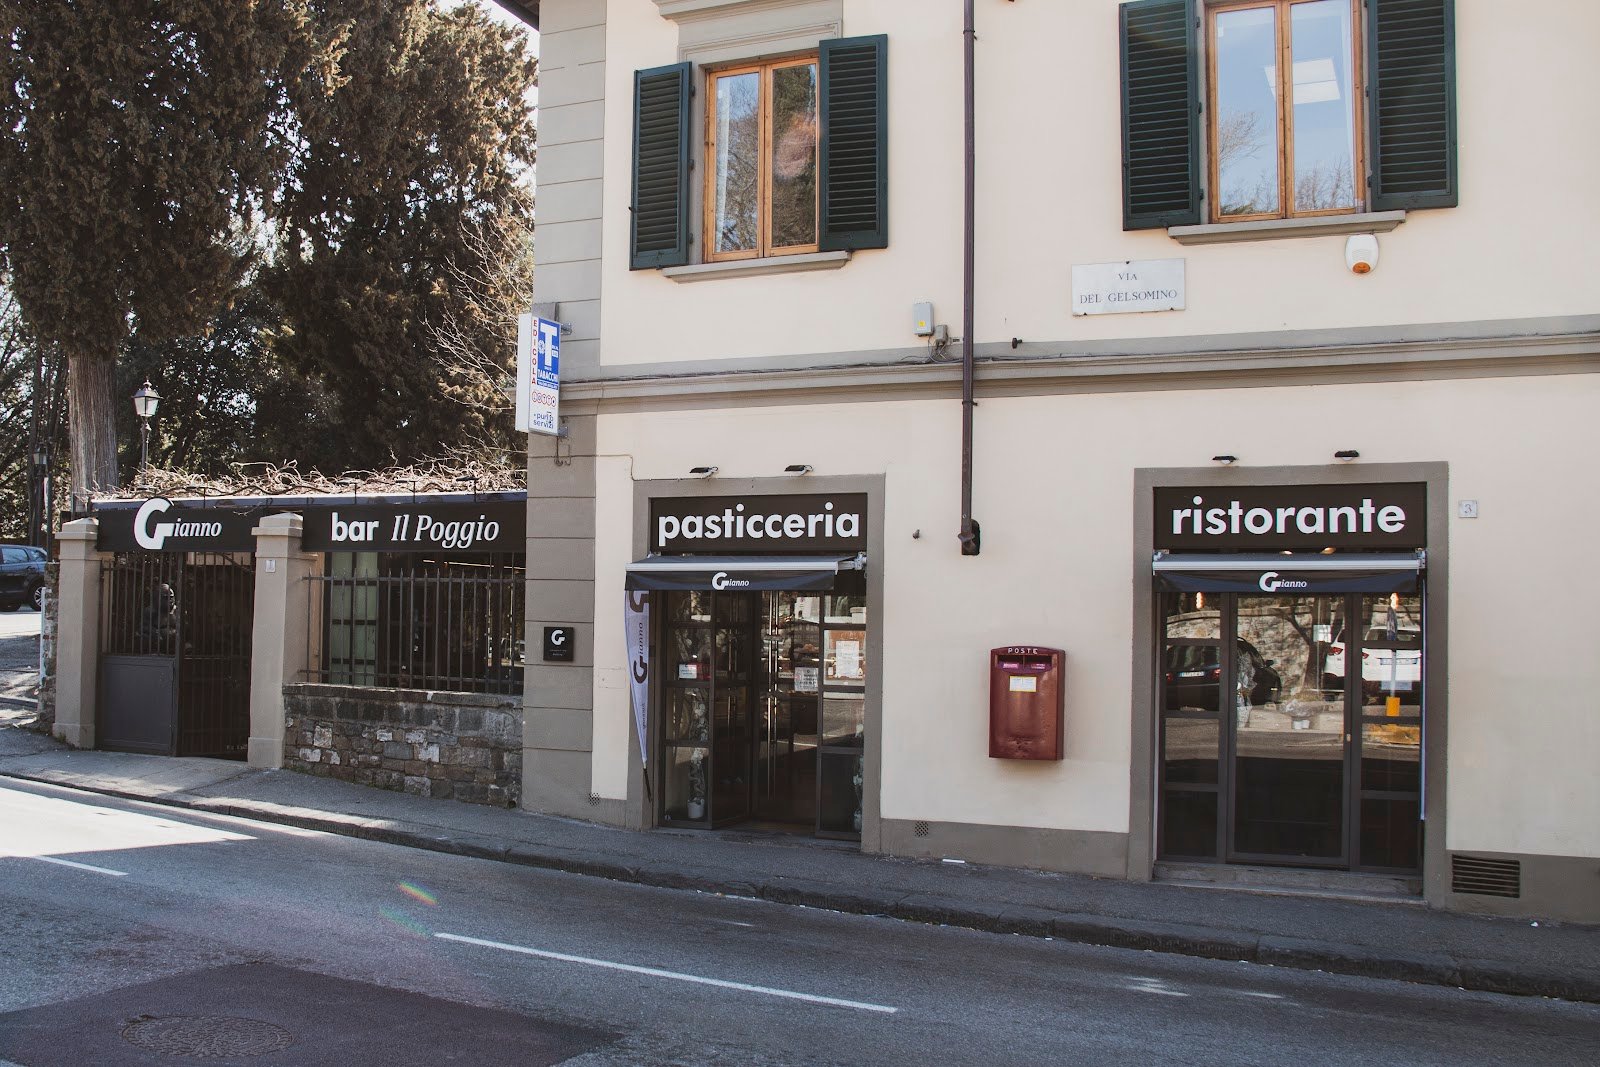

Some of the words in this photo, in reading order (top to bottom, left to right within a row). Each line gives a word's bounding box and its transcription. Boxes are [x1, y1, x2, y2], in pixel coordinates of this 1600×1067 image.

[1118, 273, 1138, 281] VIA
[1080, 293, 1101, 304] DEL
[1107, 289, 1178, 302] GELSOMINO
[533, 419, 554, 429] servizi
[1172, 495, 1406, 535] ristorante
[1464, 503, 1473, 514] 3
[134, 497, 222, 550] Gianno
[331, 511, 380, 542] bar
[390, 513, 410, 541] Il
[413, 514, 500, 549] Poggio
[658, 501, 860, 547] pasticceria
[711, 571, 750, 591] Gianno
[1258, 571, 1308, 592] Gianno
[551, 629, 566, 646] G
[633, 622, 648, 684] Gianno
